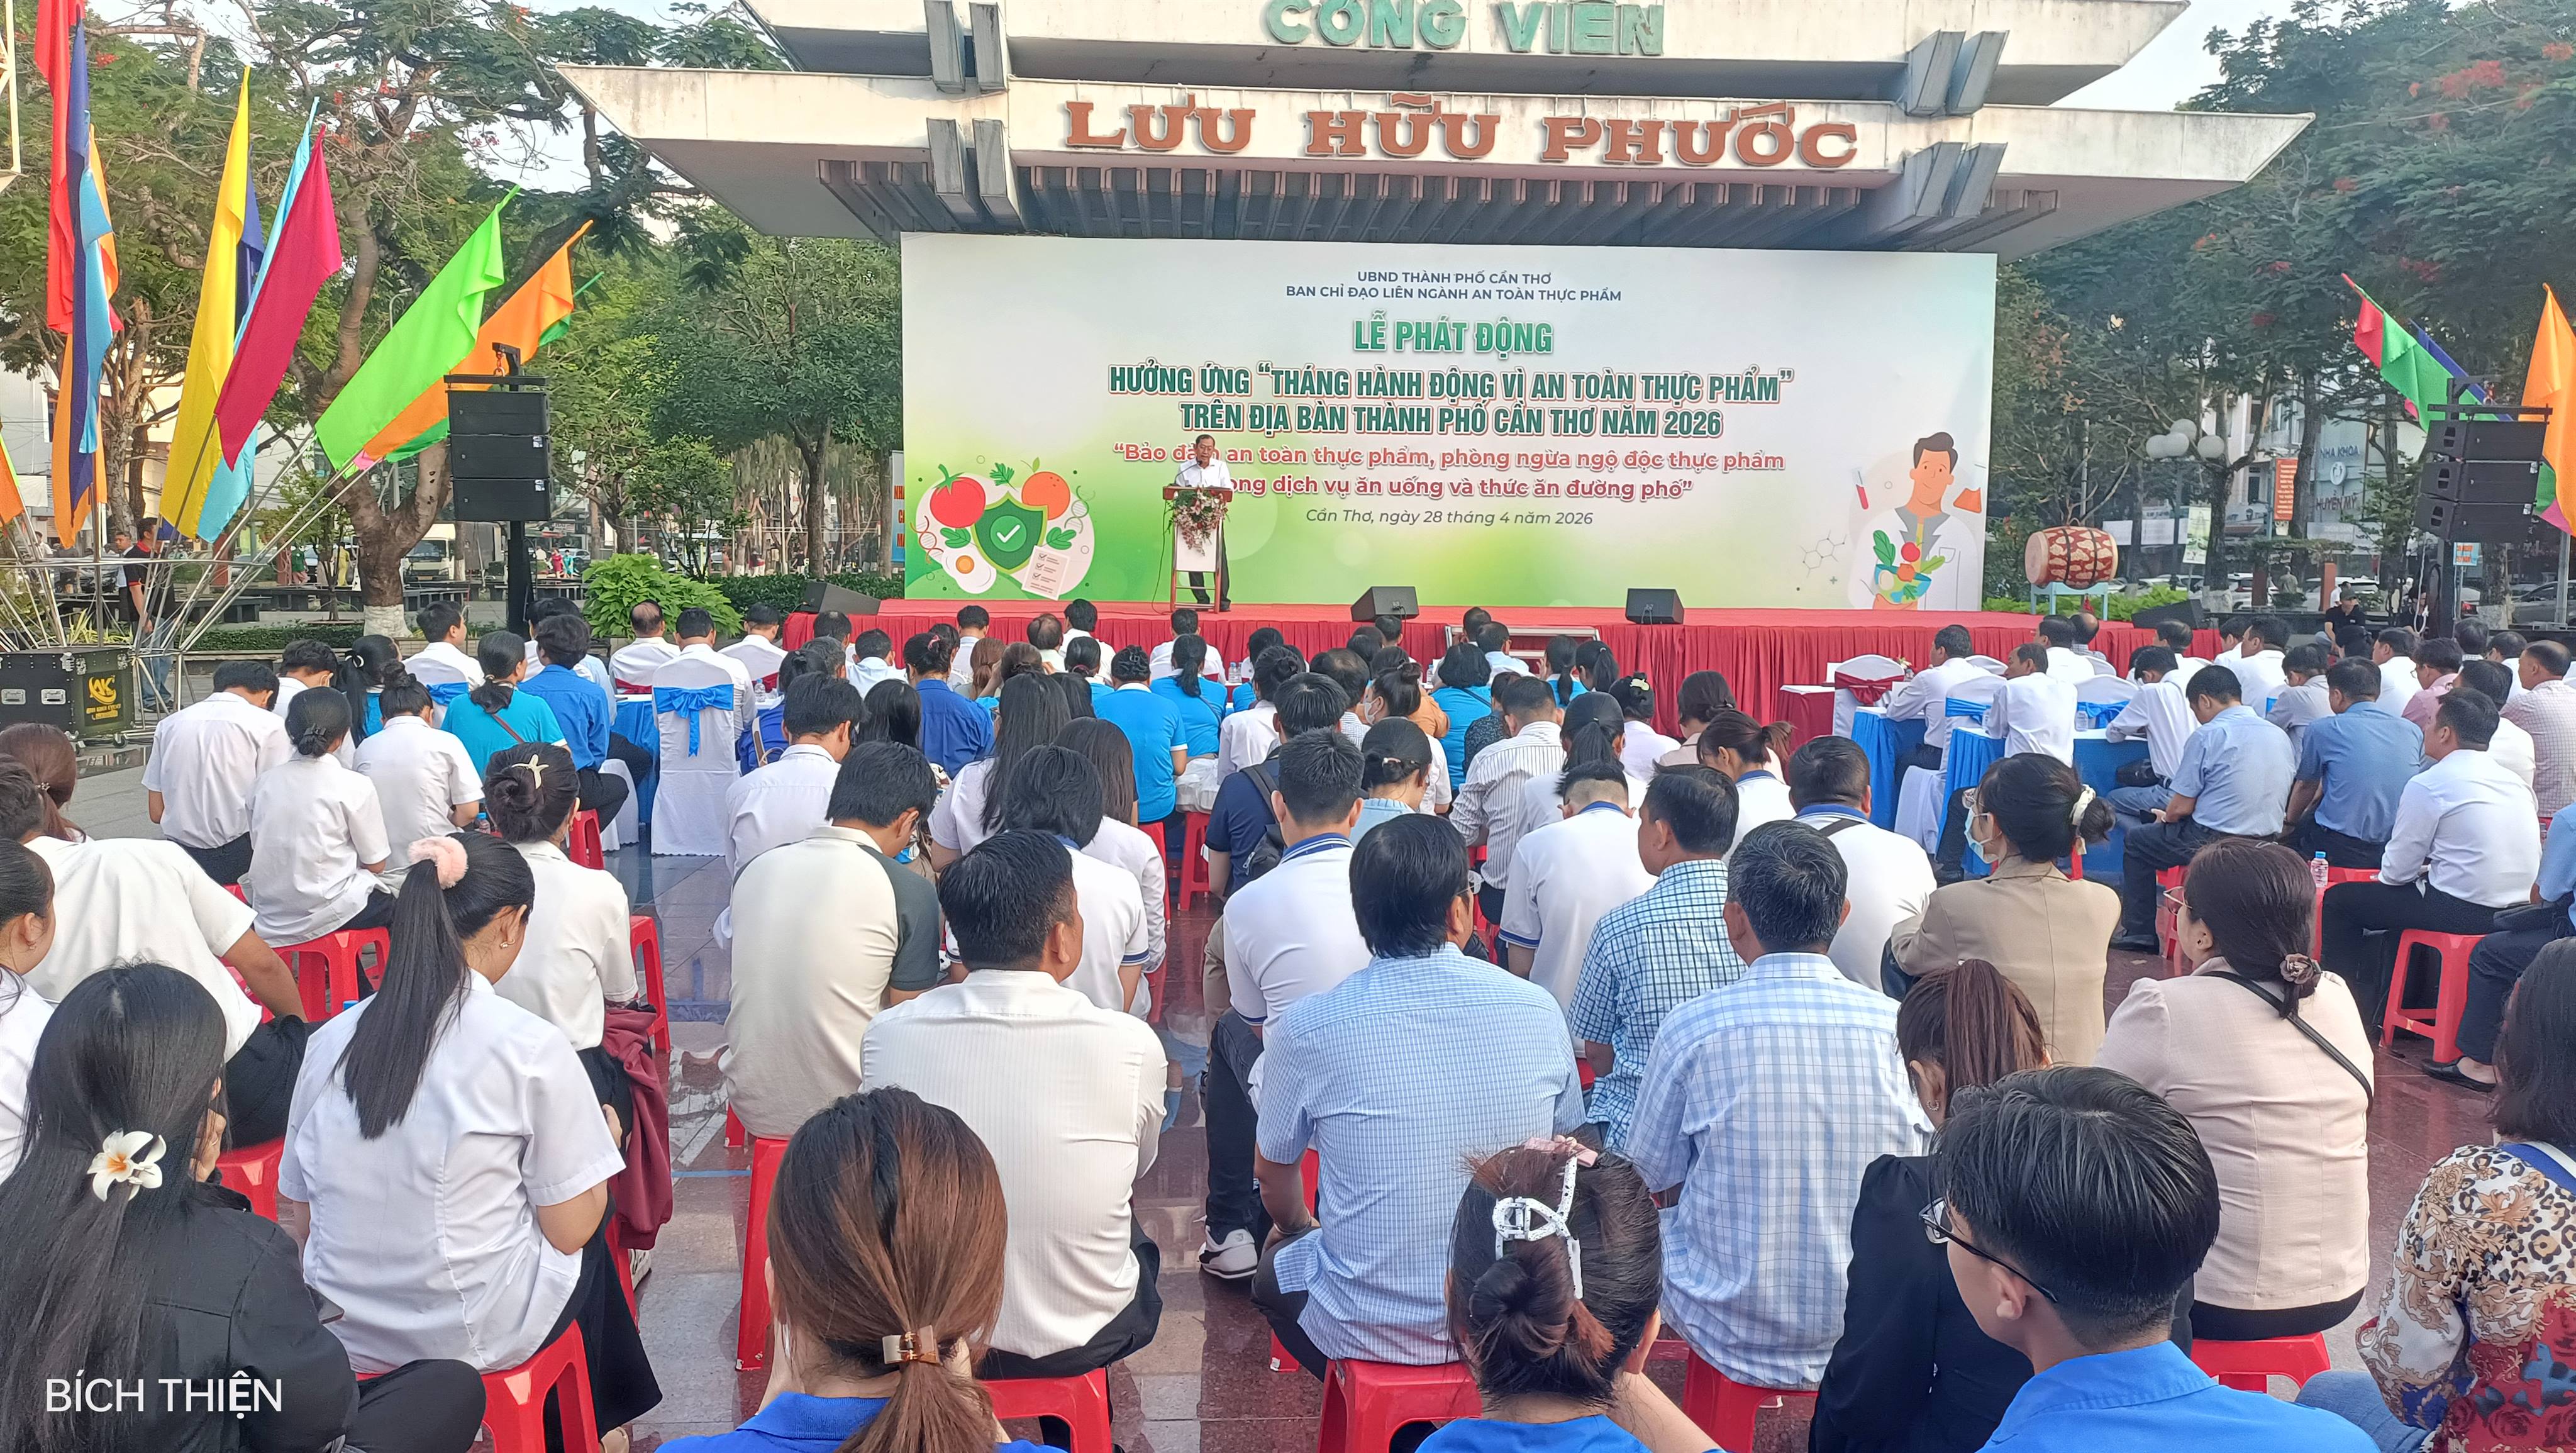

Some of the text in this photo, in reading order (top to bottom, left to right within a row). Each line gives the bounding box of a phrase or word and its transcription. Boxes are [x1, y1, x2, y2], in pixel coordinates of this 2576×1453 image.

[1065, 92, 1857, 167] LƯU HỮU PHƯỚC
[1357, 269, 1552, 285] UBND THÀNH PHỐ CẦN THƠ
[1286, 283, 1622, 303] BAN CHỈ ĐẠO LIÊN NGÀNH AN TOÀN THỰC PHẨM
[1353, 309, 1553, 359] LỄ PHÁT ĐỘNG
[1109, 359, 1792, 406] HƯỞNG ỨNG “THÁNG HÀNH ĐỘNG VÌ AN TOÀN THỰC PHẨM”
[1180, 398, 1723, 436] TRÊN ĐỊA BÀN THÀNH PHỐ CẦN THƠ NĂM 2026
[1113, 442, 1166, 461] “Bảo
[1227, 448, 1253, 461] an
[1259, 444, 1307, 462] toàn
[1313, 447, 1363, 469] thực
[1368, 444, 1435, 468] phẩm,
[1441, 448, 1510, 470] phòng
[1516, 450, 1570, 470] ngừa
[1577, 451, 1619, 472] ngộ
[1624, 450, 1663, 471] độc
[1668, 452, 1719, 473] thực
[1723, 448, 1784, 472] phẩm
[1272, 475, 1318, 494] dịch
[1323, 480, 1350, 495] vụ
[1355, 476, 1382, 493] ăn
[1389, 473, 1444, 498] uống
[1449, 479, 1474, 495] và
[1479, 479, 1530, 496] thức
[1533, 480, 1560, 496] ăn
[1566, 479, 1635, 500] đường
[1640, 480, 1692, 501] phố”
[1306, 509, 1593, 526] Cần Thơ, ngày 28 tháng 4 năm 2026
